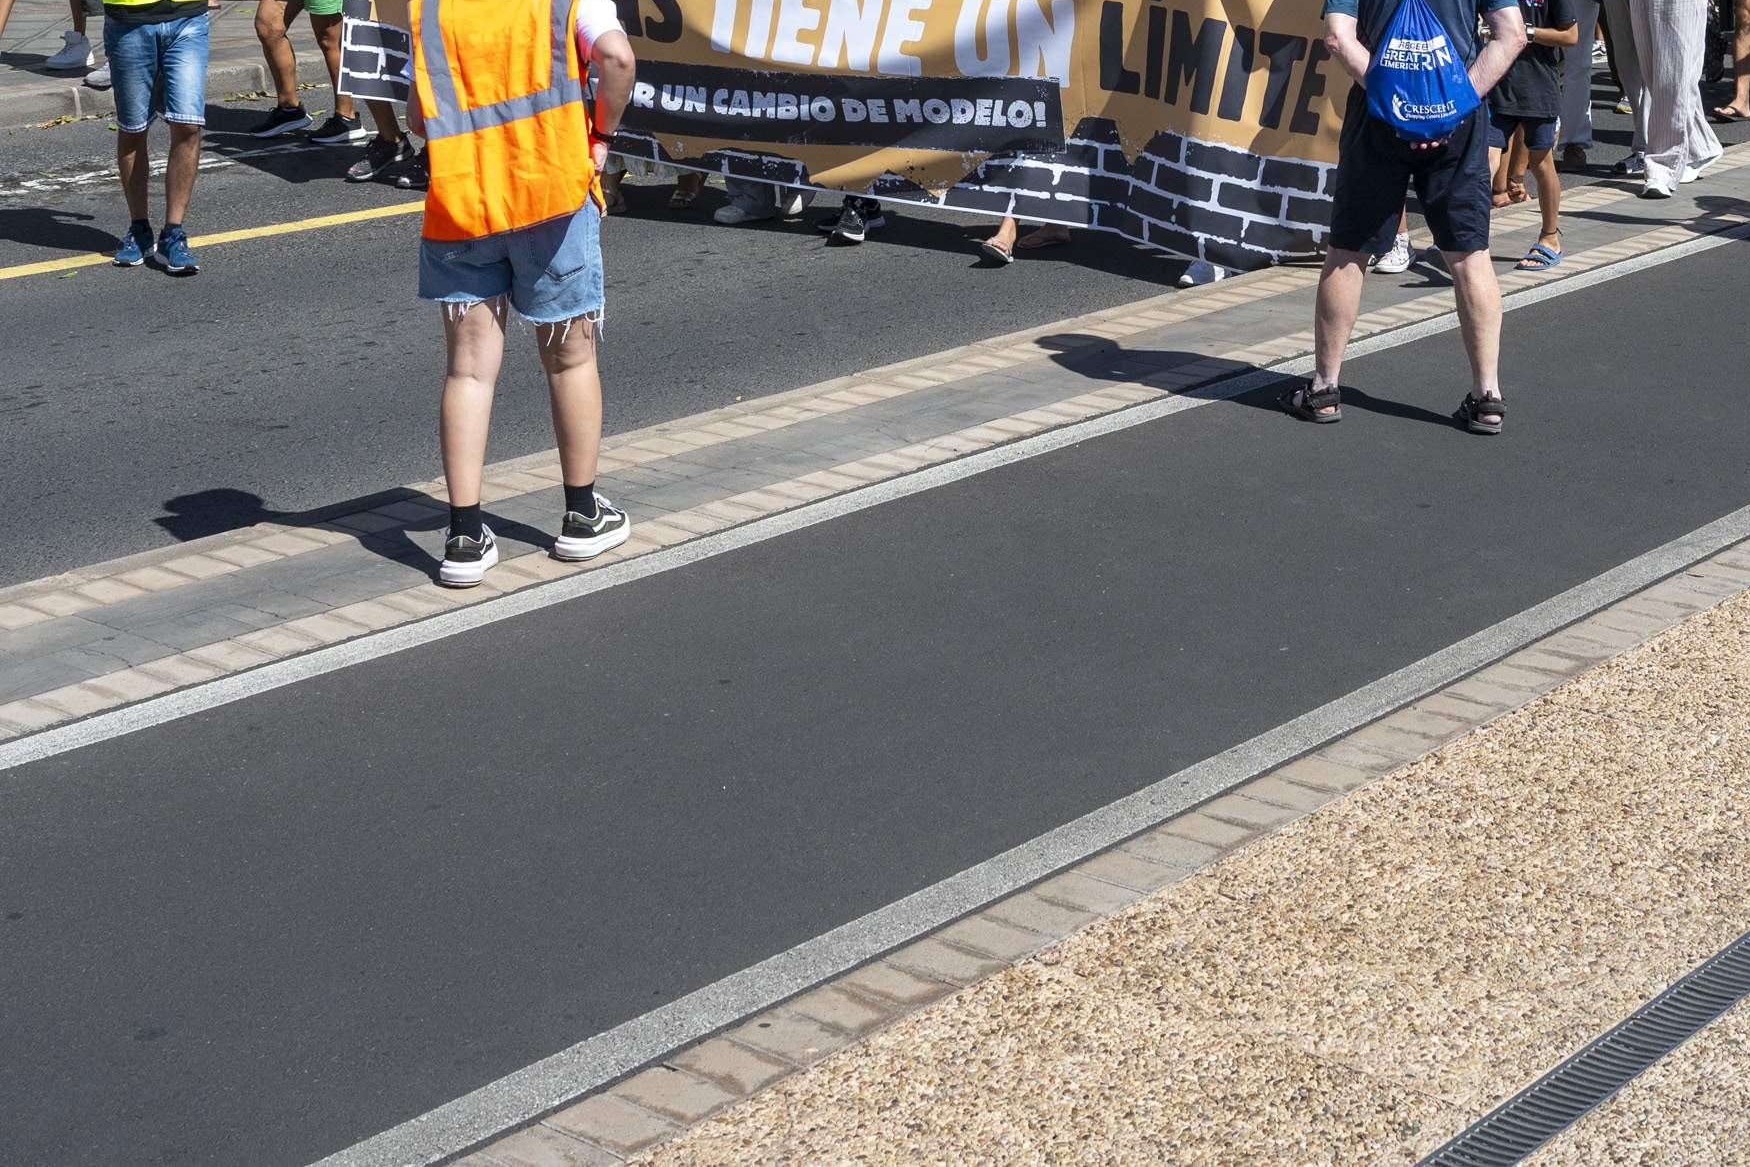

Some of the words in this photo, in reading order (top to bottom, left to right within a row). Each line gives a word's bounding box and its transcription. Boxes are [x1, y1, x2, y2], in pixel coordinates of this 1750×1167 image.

[1383, 50, 1421, 63] GREAT
[660, 83, 706, 114] UN
[712, 89, 837, 122] CAMBIO
[841, 97, 888, 122] DE
[895, 97, 1048, 128] MODELO!
[1404, 100, 1455, 114] CRESCENT
